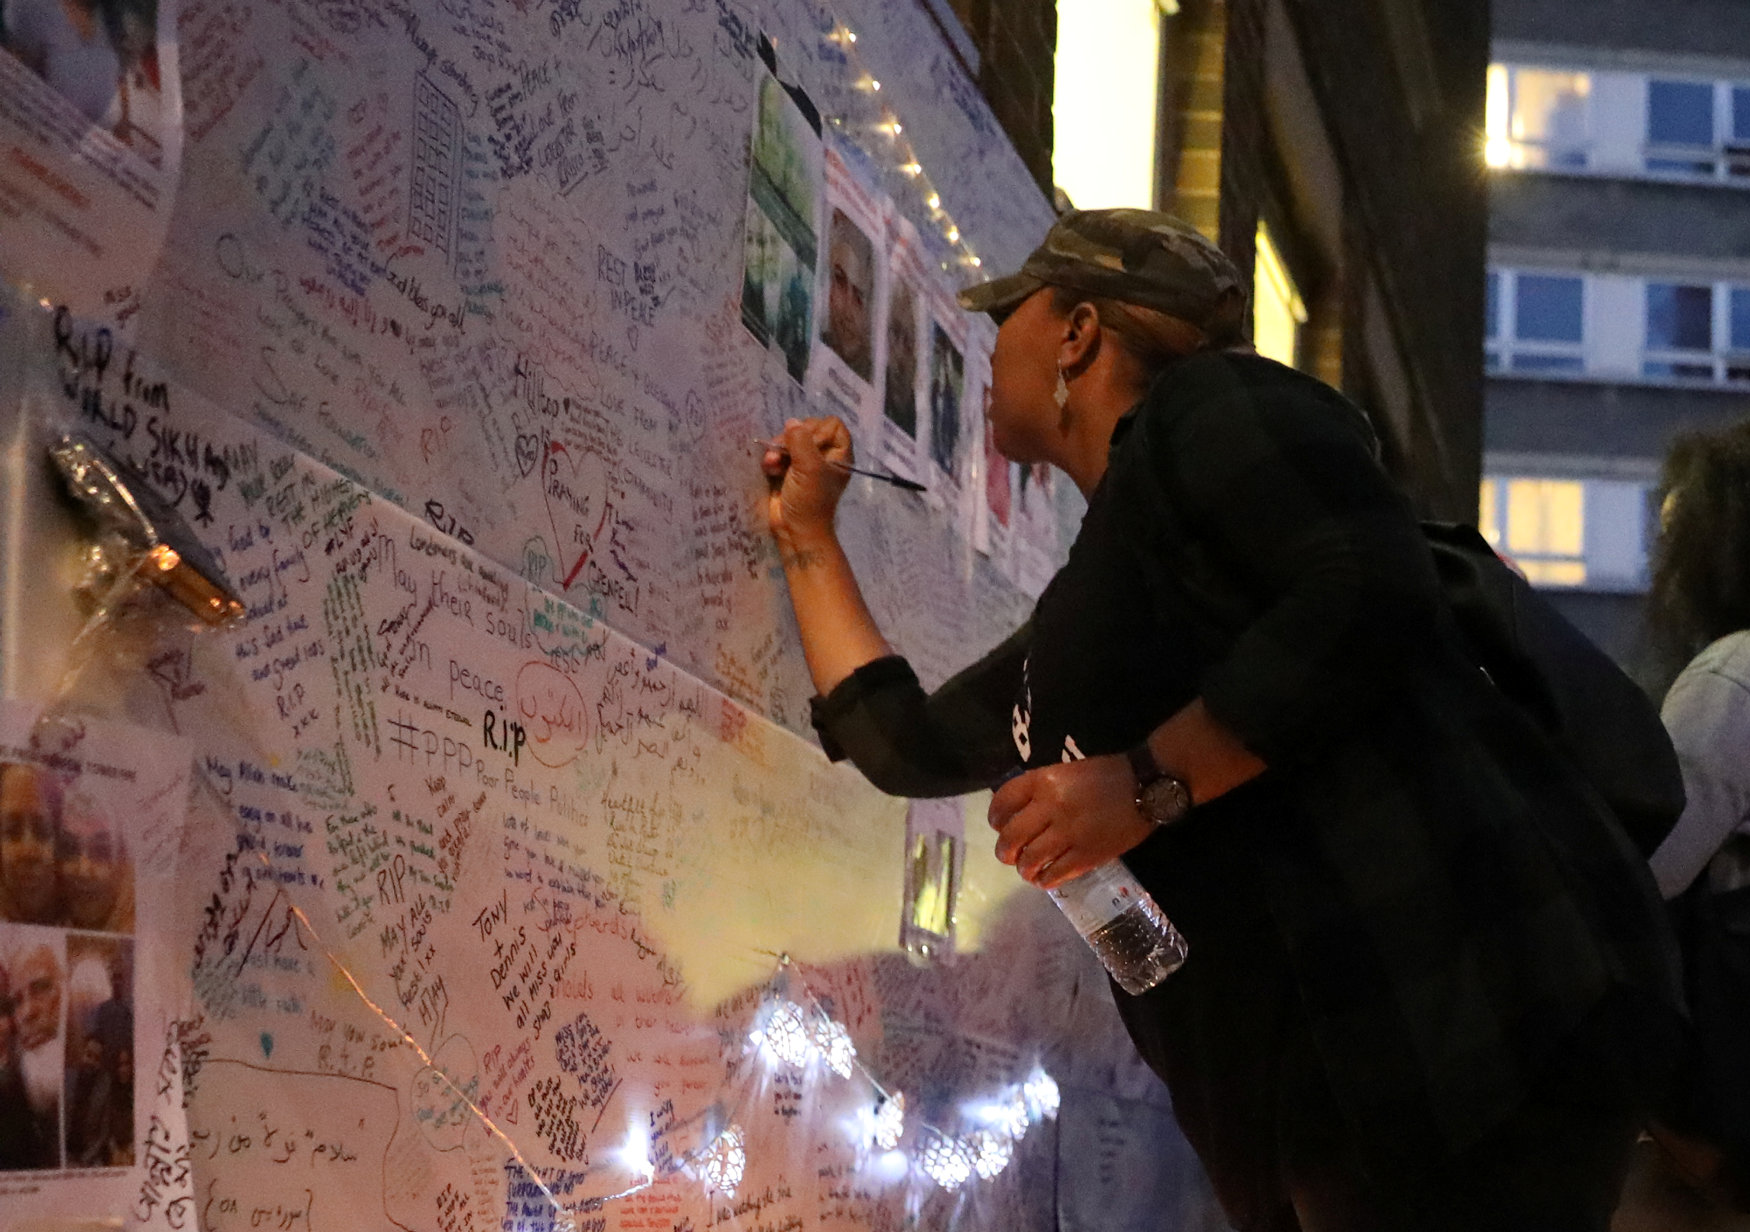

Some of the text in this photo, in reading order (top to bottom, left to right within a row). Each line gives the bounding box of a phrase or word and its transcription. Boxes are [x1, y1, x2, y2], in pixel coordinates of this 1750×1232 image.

[424, 499, 475, 547] RIP
[504, 768, 542, 811] People
[376, 853, 406, 906] RIP
[472, 889, 508, 943] TONY
[490, 925, 527, 991] Dennis
[516, 1000, 530, 1030] all
[483, 1044, 501, 1076] RIP
